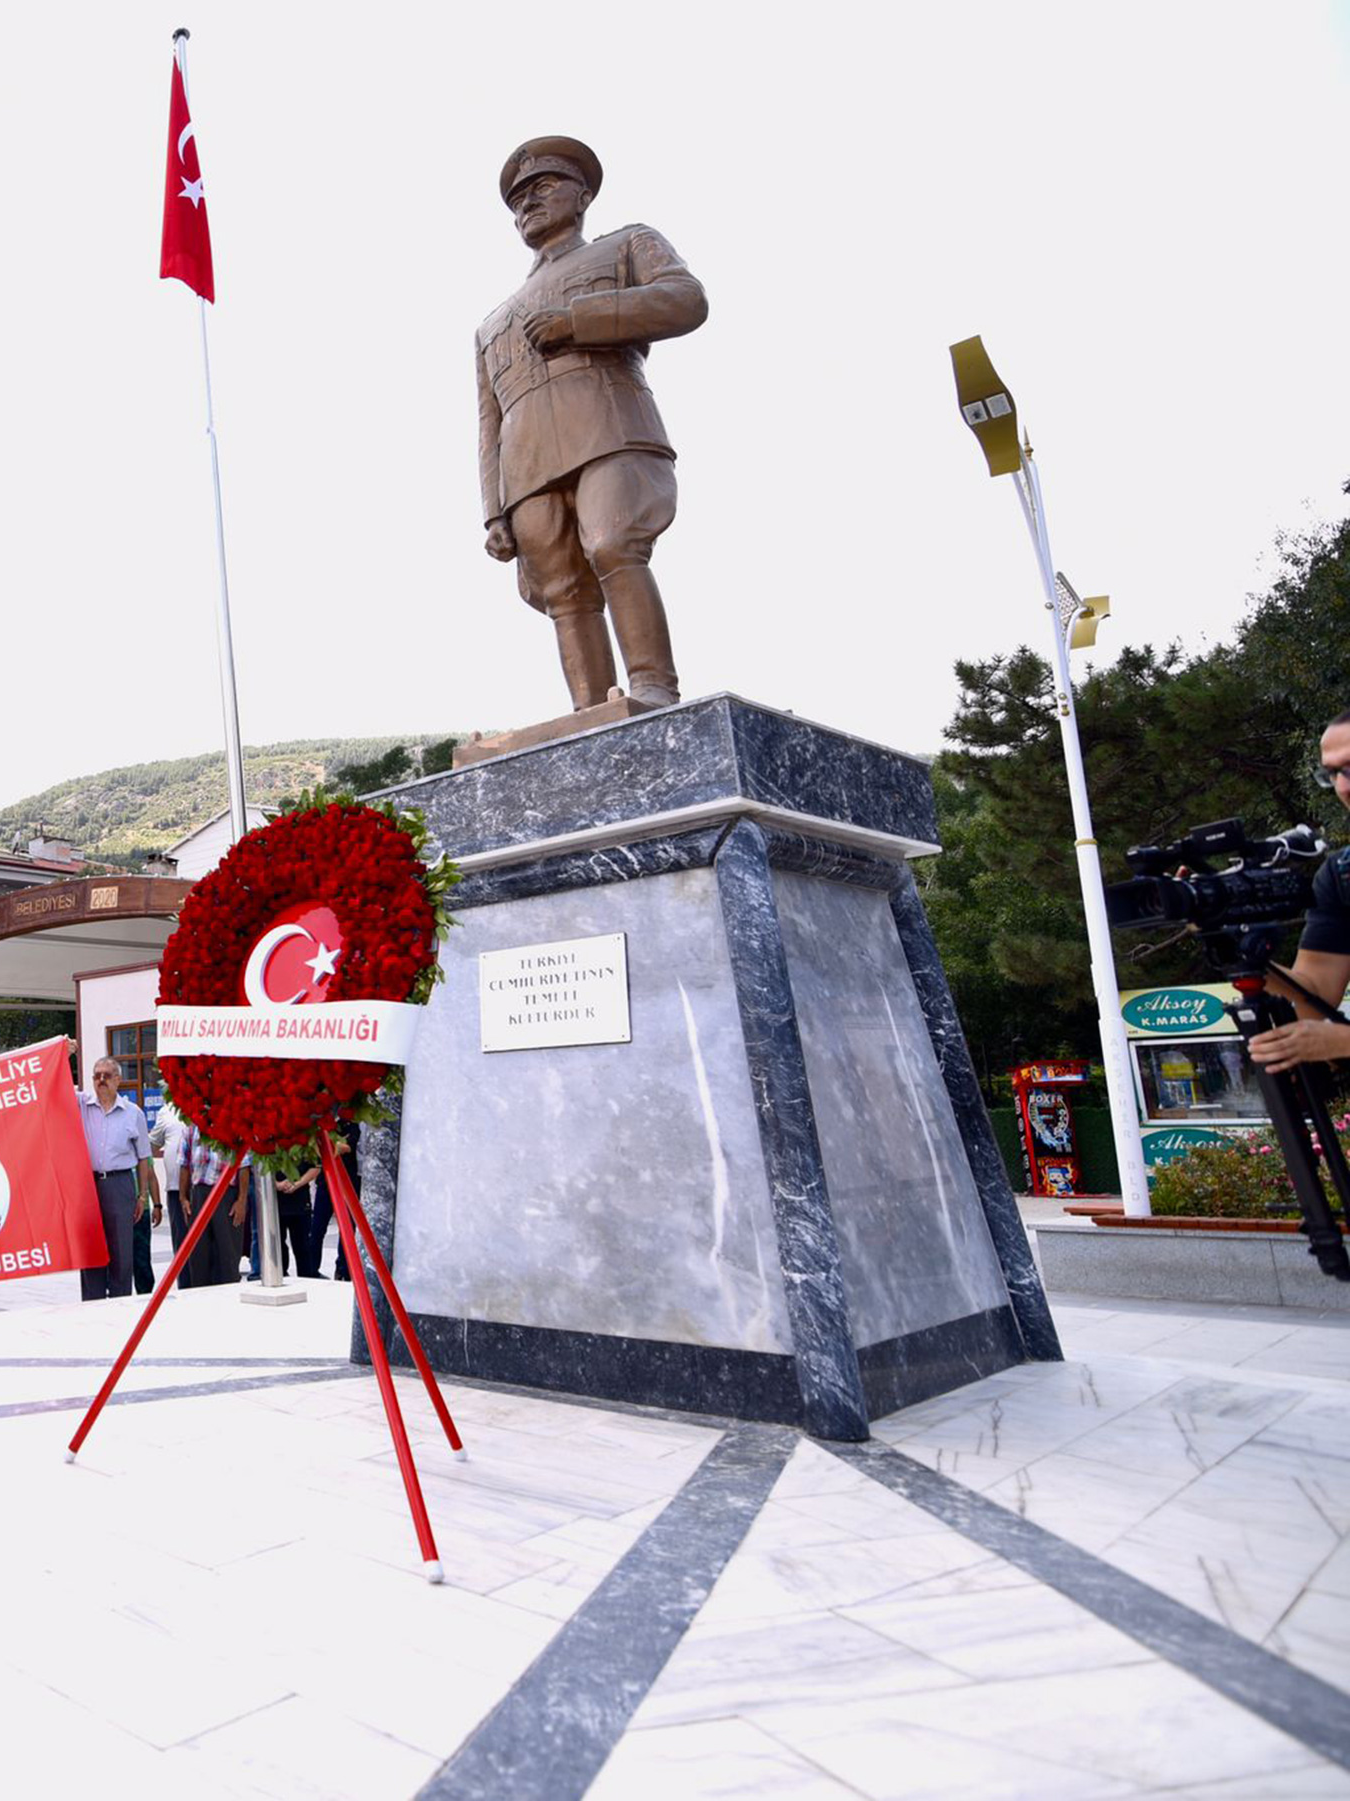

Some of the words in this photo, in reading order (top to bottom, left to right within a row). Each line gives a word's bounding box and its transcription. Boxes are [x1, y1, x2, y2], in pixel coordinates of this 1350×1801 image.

[91, 889, 118, 907] 2020
[1137, 994, 1206, 1014] Aksoy
[161, 1015, 196, 1038] MİLLİ
[197, 1018, 271, 1038] SAVUNMA
[276, 1014, 379, 1042] BAKANLIĞI
